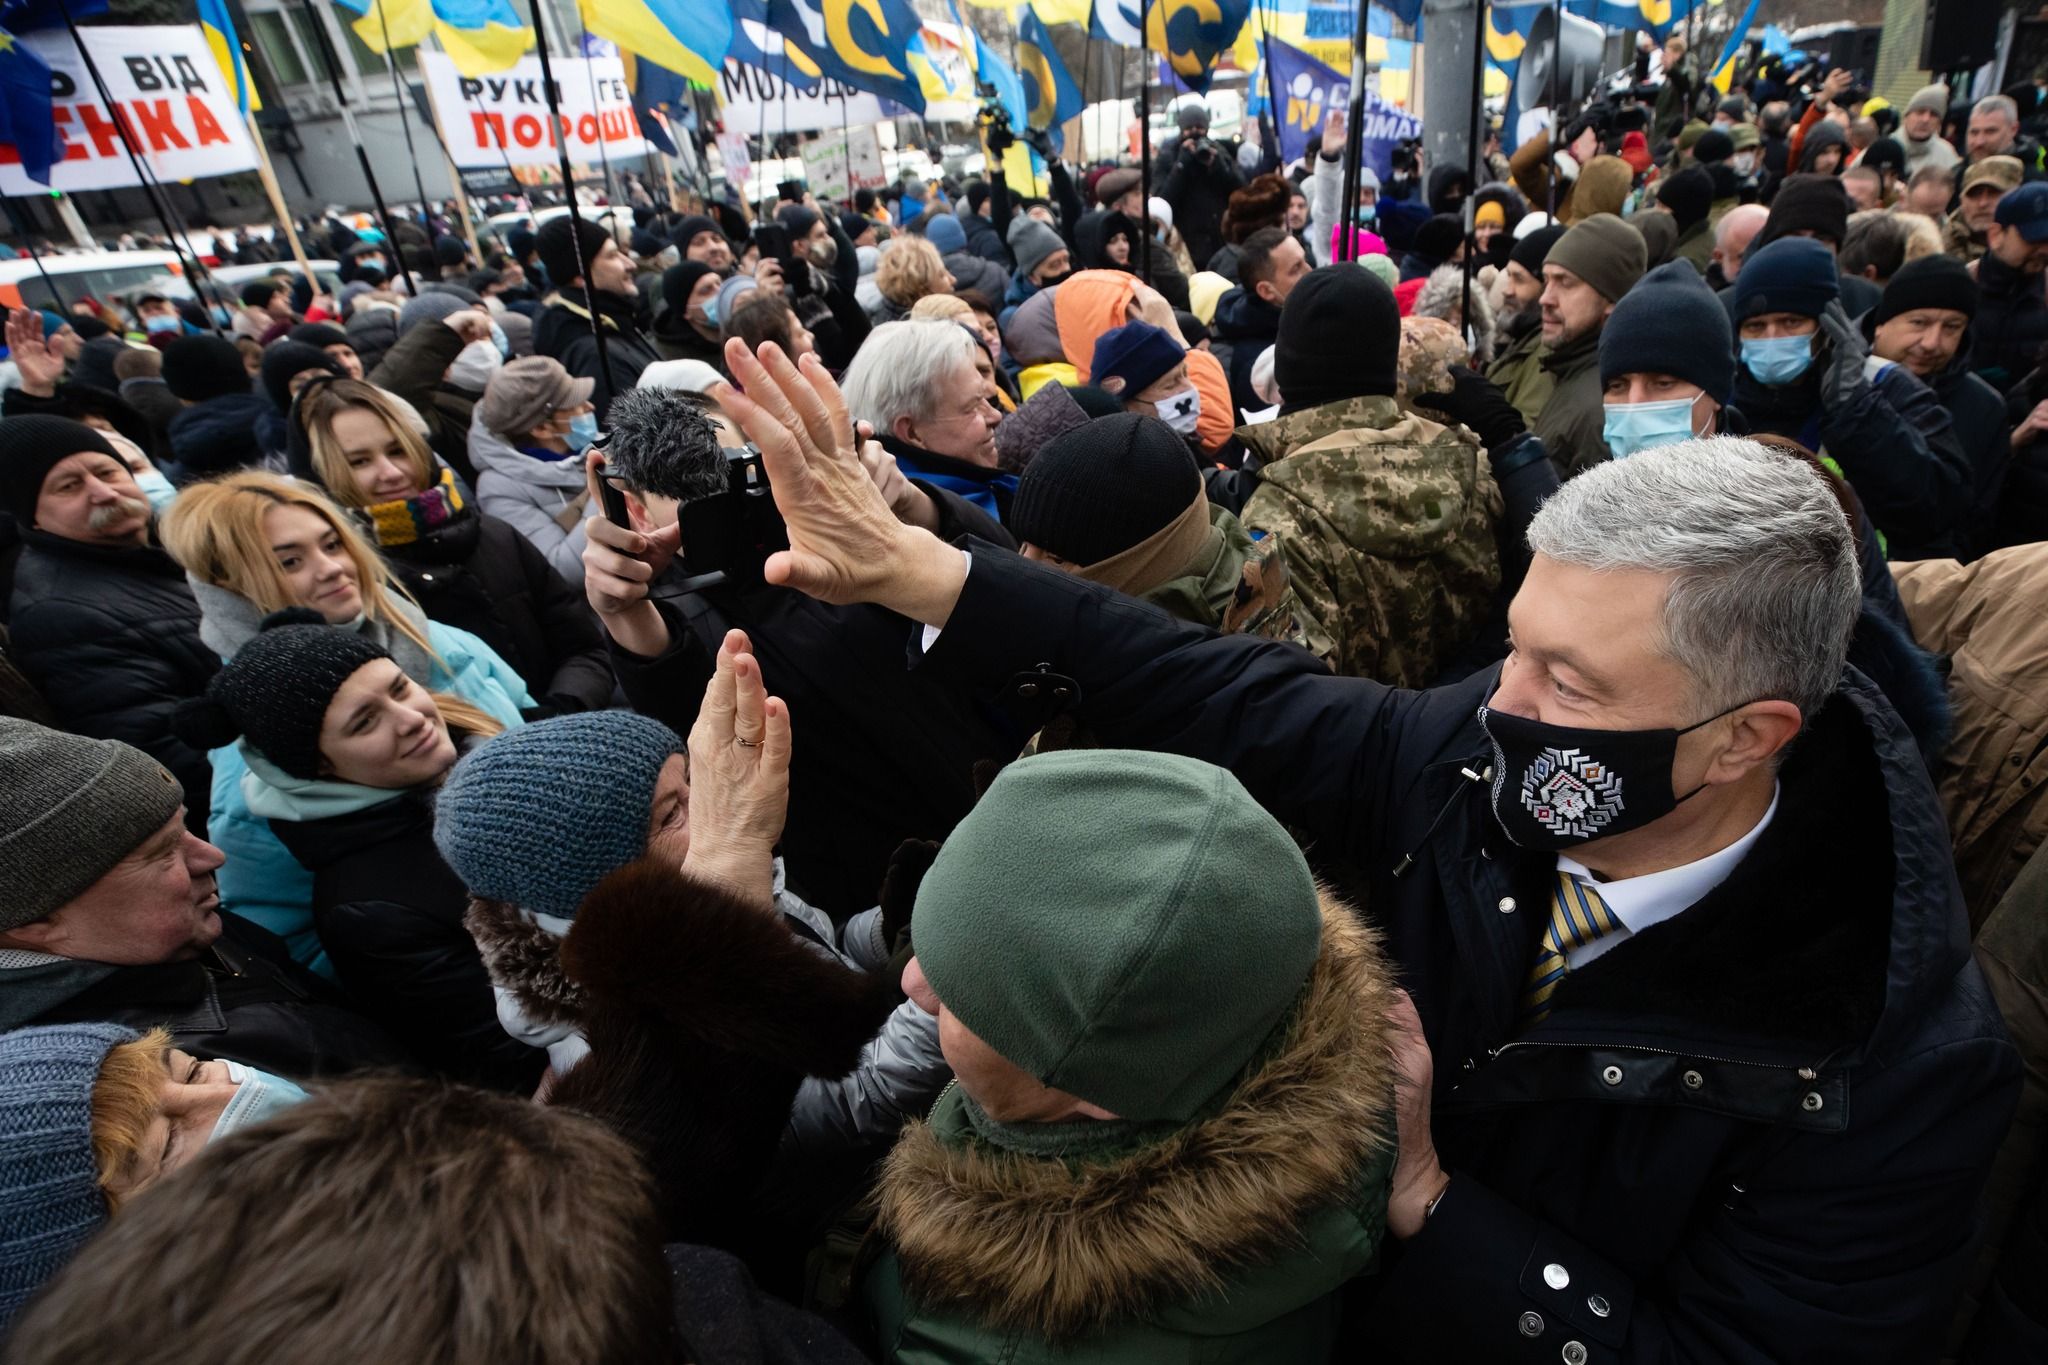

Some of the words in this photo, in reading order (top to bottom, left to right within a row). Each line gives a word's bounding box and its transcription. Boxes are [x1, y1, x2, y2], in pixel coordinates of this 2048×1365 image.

[123, 55, 209, 94] ВІД
[597, 79, 625, 102] ГЕ
[722, 57, 858, 105] МОД
[0, 94, 231, 165] ЕНКА
